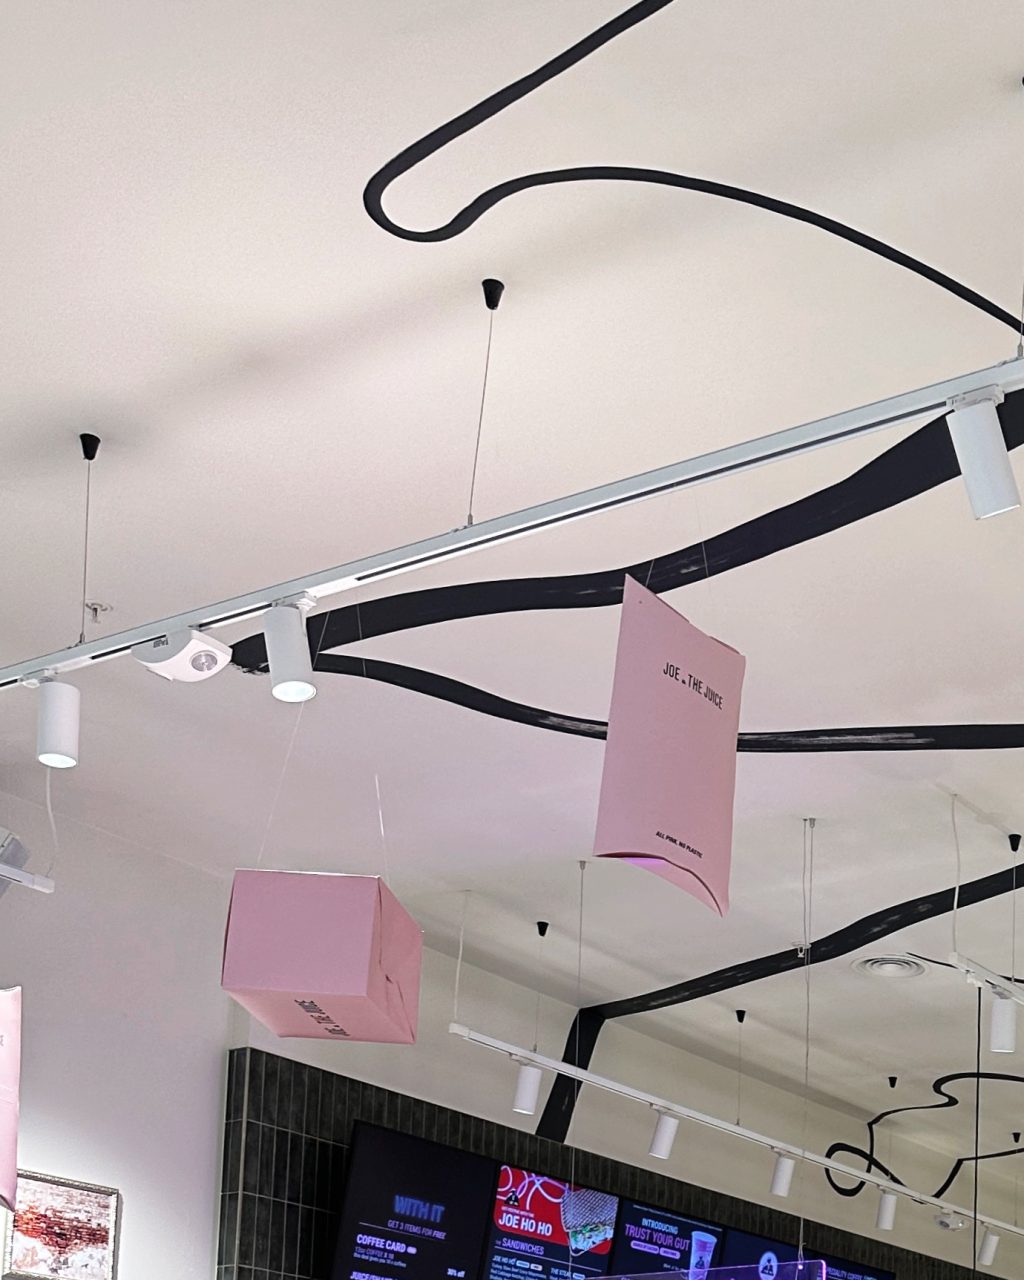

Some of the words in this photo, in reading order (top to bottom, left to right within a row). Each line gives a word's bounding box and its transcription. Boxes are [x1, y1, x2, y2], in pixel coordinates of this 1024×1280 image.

[663, 662, 680, 681] JOE
[688, 674, 703, 695] THE
[703, 686, 724, 711] JUICE
[394, 1194, 430, 1220] WITH
[430, 1203, 446, 1223] IT
[387, 1219, 399, 1229] GET
[499, 1212, 520, 1229] JOE
[520, 1217, 536, 1233] HO
[537, 1220, 552, 1236] HO
[641, 1217, 678, 1235] INTRODUCING
[356, 1234, 385, 1249] COFFEE
[385, 1240, 407, 1253] CARD
[502, 1238, 545, 1255] SANDWICHES
[625, 1223, 652, 1241] TRUST
[652, 1230, 674, 1247] YOUR
[674, 1237, 691, 1251] GUT
